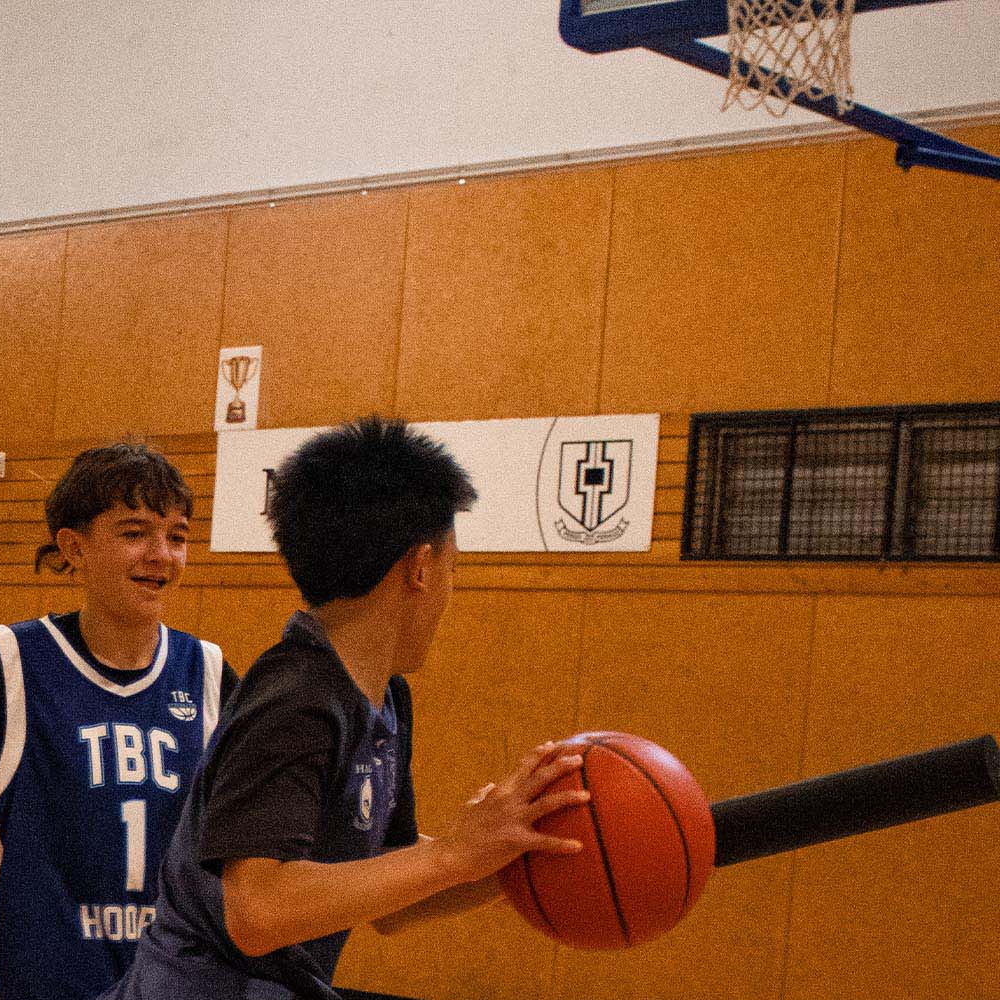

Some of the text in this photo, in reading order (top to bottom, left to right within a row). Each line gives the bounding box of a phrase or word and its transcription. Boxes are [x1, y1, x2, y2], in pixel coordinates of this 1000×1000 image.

[170, 690, 193, 703] TBC
[79, 723, 180, 793] TBC
[121, 800, 146, 891] 1
